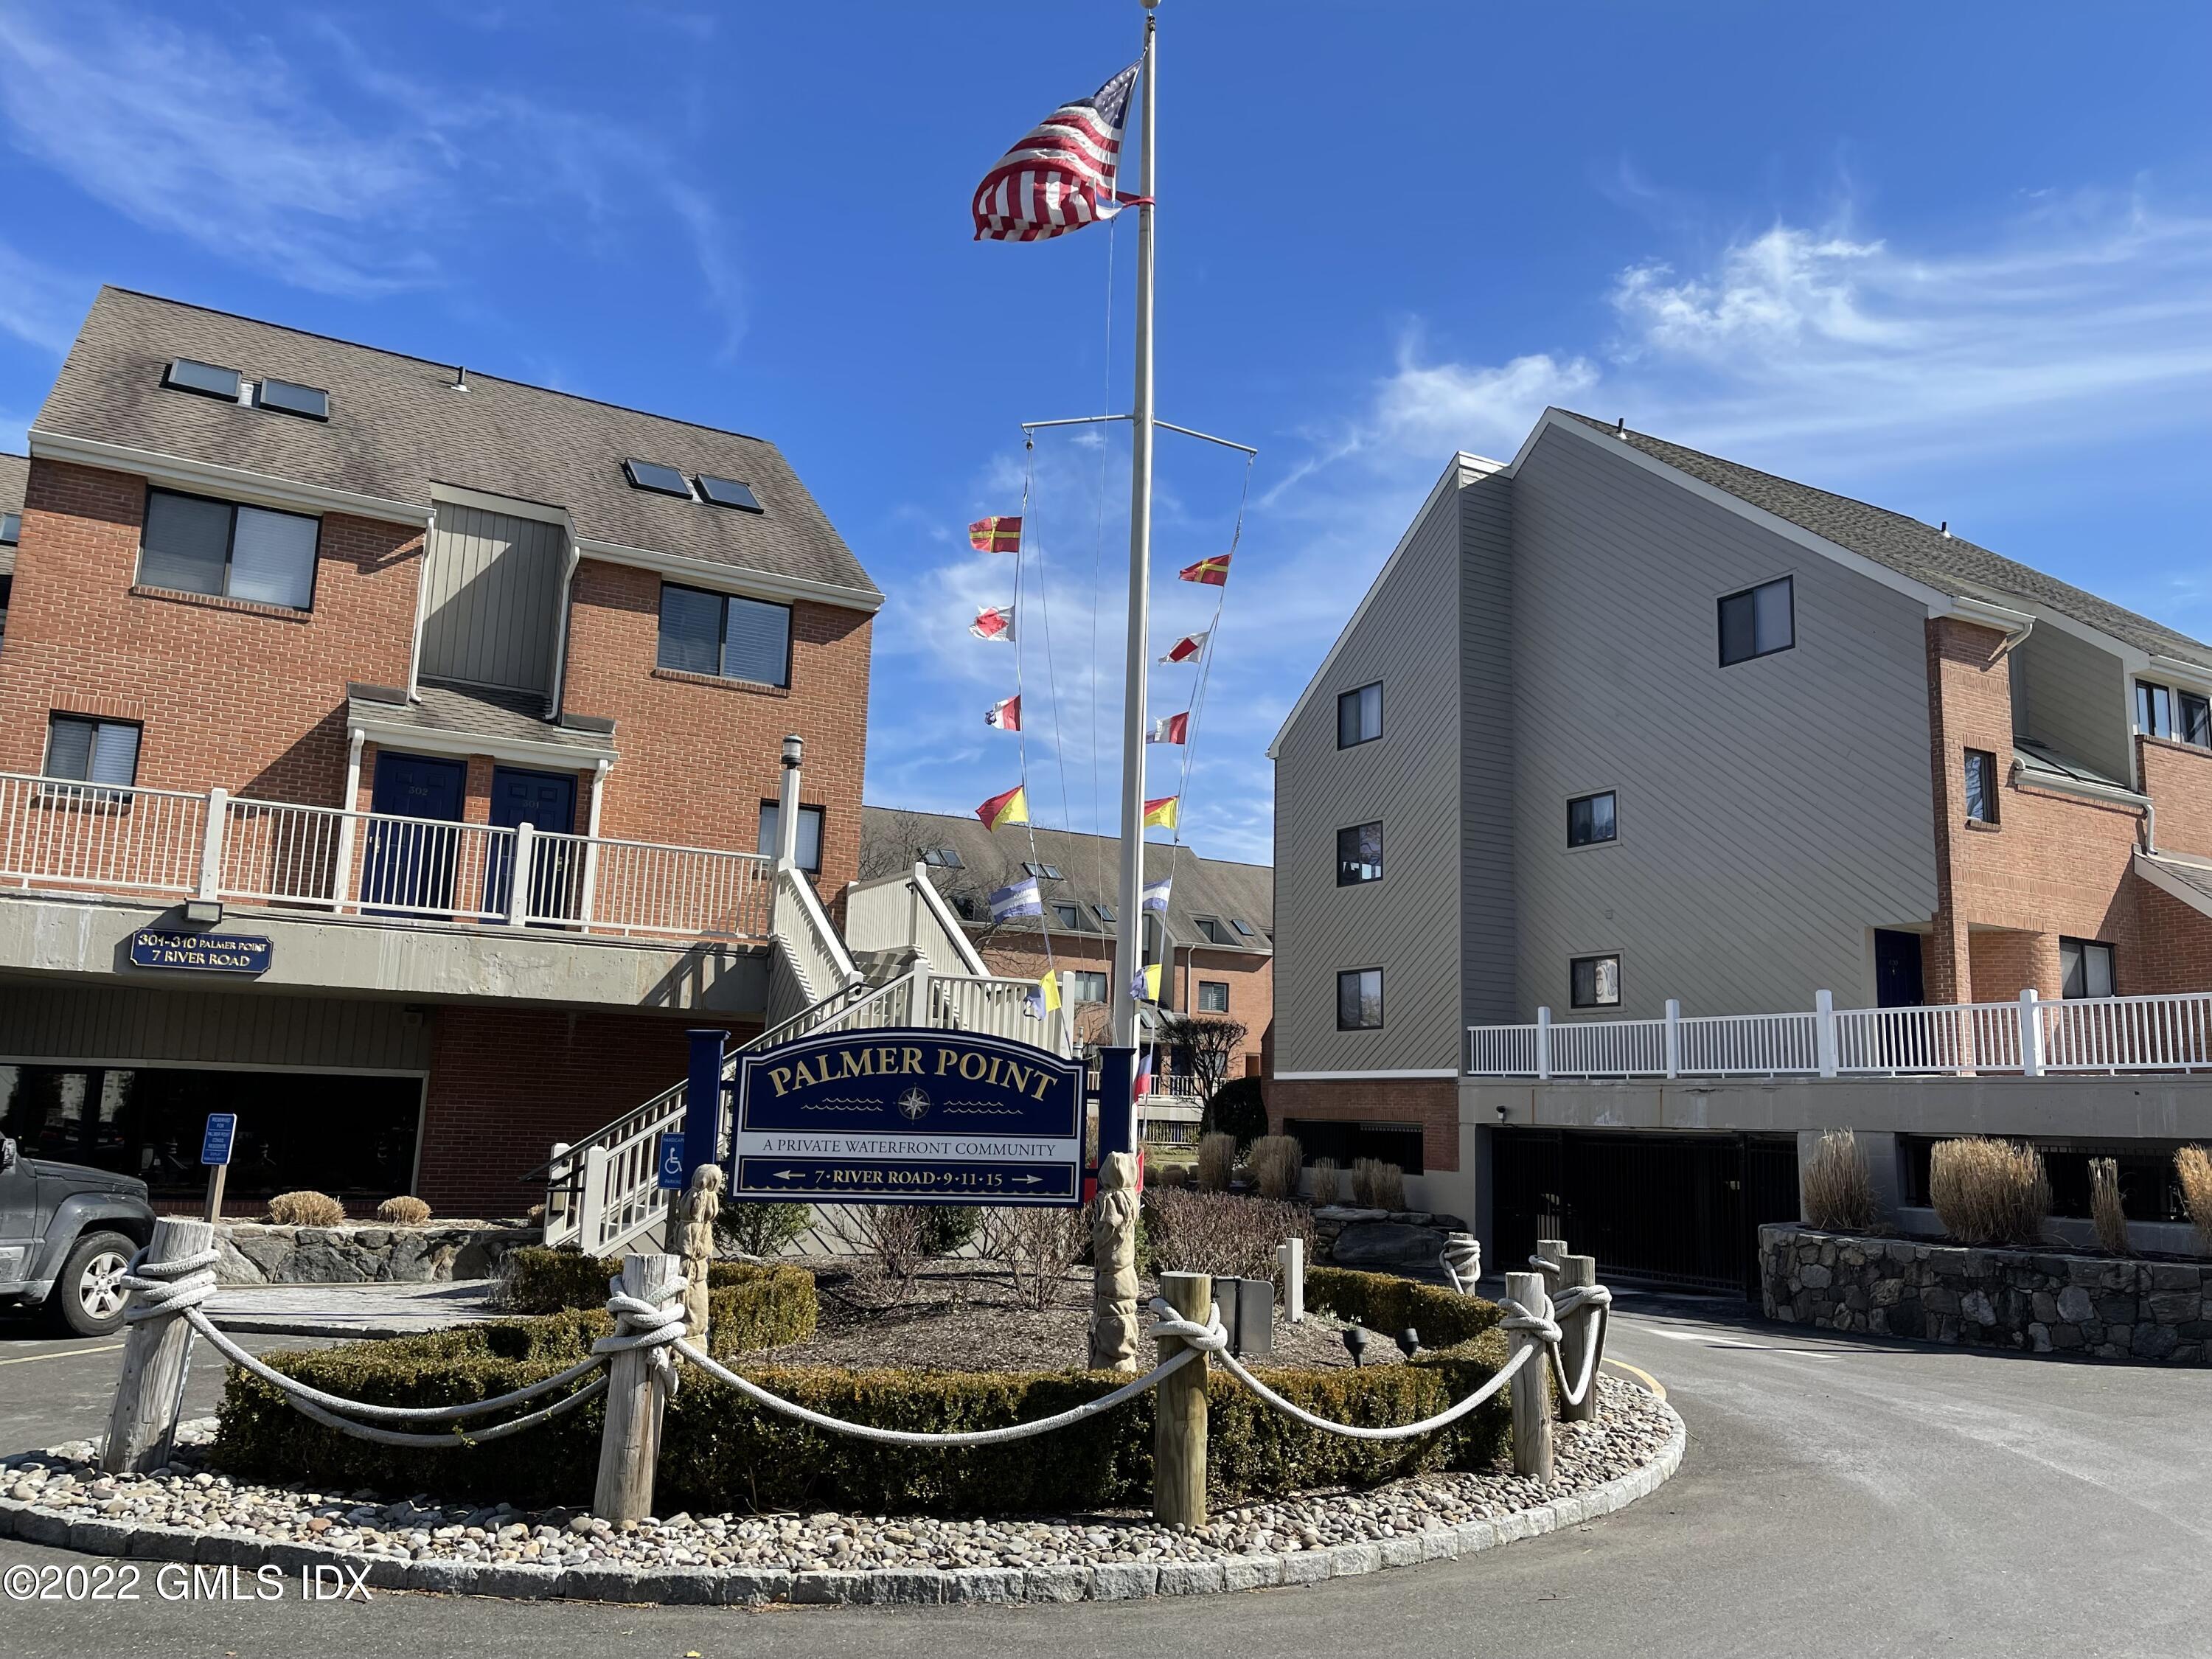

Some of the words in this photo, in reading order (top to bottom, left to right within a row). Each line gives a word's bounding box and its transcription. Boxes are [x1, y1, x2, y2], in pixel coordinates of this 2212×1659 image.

[138, 934, 196, 949] 301-310
[199, 939, 237, 950] PALMER
[238, 942, 267, 952] POINT
[152, 950, 161, 961] 7
[164, 950, 206, 964] RIVER
[209, 954, 251, 967] ROAD
[768, 1047, 925, 1097] PALMER
[933, 1048, 1058, 1101] POINT
[762, 1140, 773, 1151] A
[778, 1140, 841, 1152] PRIVATE
[845, 1141, 952, 1155] WATERFRONT
[955, 1143, 1056, 1156] COMMUNITY
